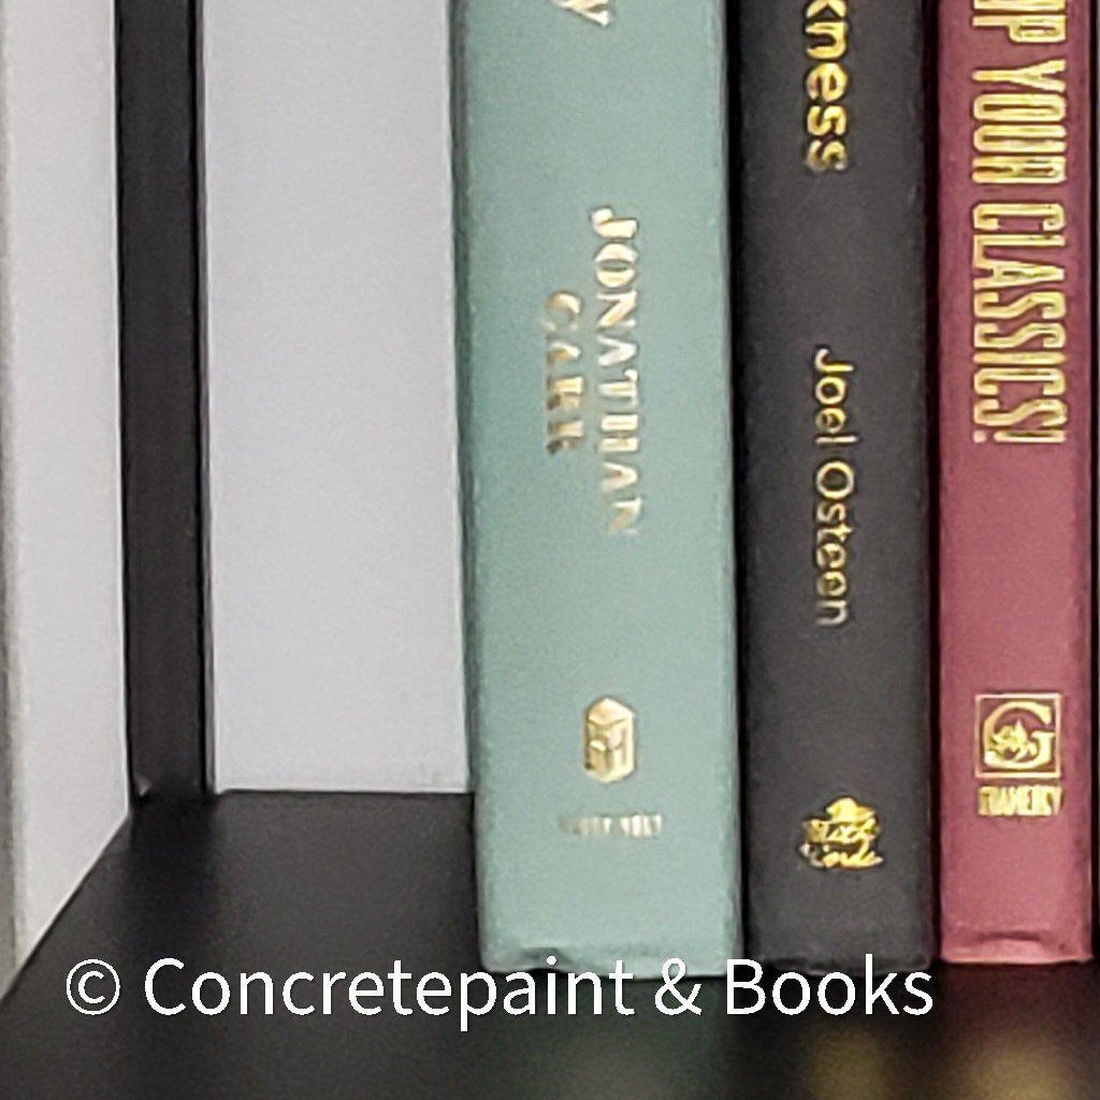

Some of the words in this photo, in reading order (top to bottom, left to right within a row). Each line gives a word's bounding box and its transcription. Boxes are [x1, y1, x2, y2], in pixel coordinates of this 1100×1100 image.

[973, 60, 1067, 184] YOUR
[591, 207, 642, 536] JONATHAN
[815, 348, 858, 443] Joel
[973, 204, 1067, 444] CLASSICS!
[815, 461, 854, 626] Osteen
